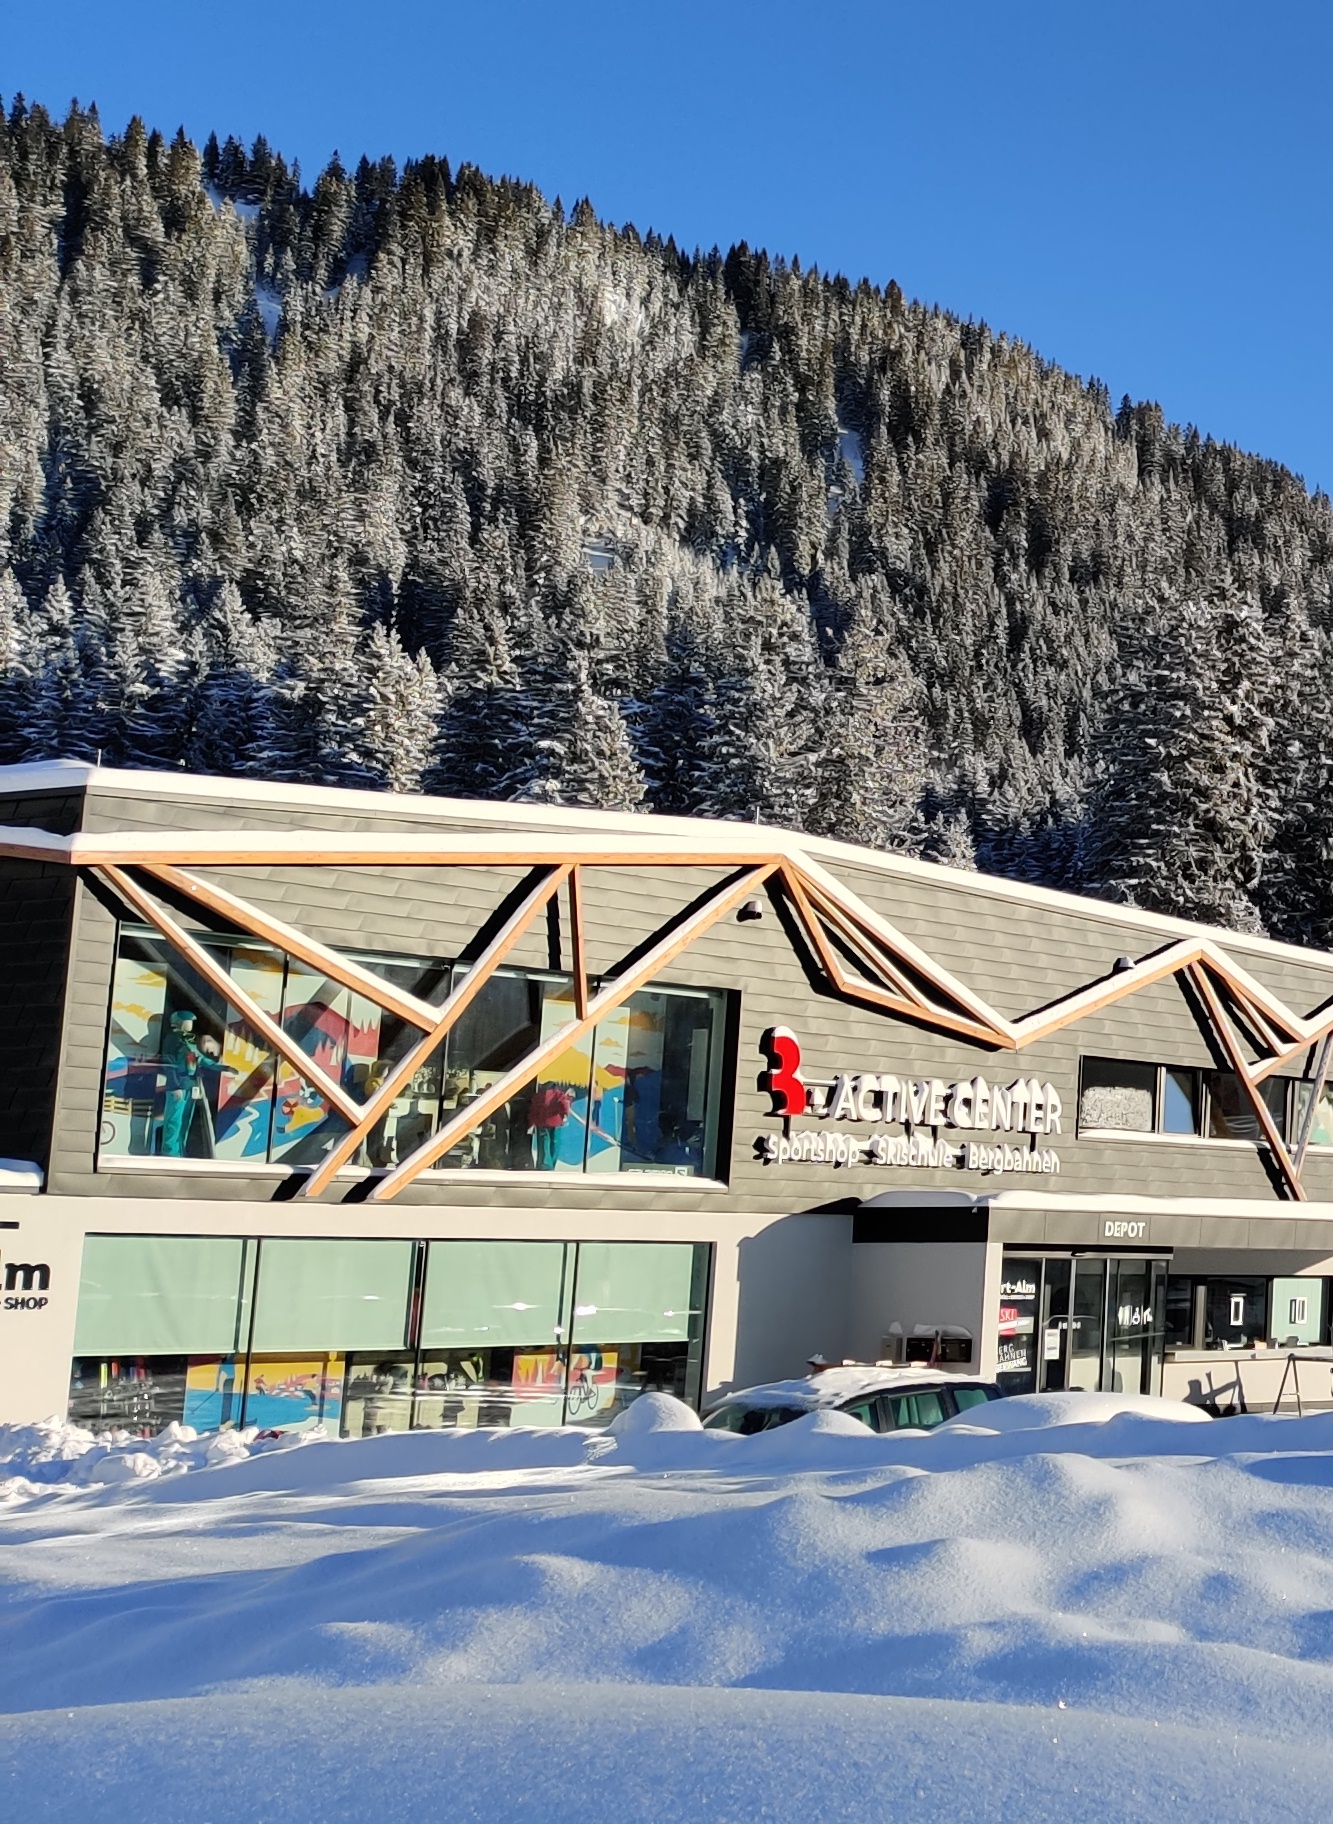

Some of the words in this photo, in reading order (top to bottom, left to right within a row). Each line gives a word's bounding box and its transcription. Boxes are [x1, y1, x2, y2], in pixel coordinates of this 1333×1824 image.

[834, 1076, 948, 1126] ACTIVE
[951, 1077, 1062, 1135] CENTER
[968, 1143, 1061, 1175] Bergbahnen
[1104, 1220, 1146, 1238] DEPOT
[3, 1296, 49, 1310] SHOP
